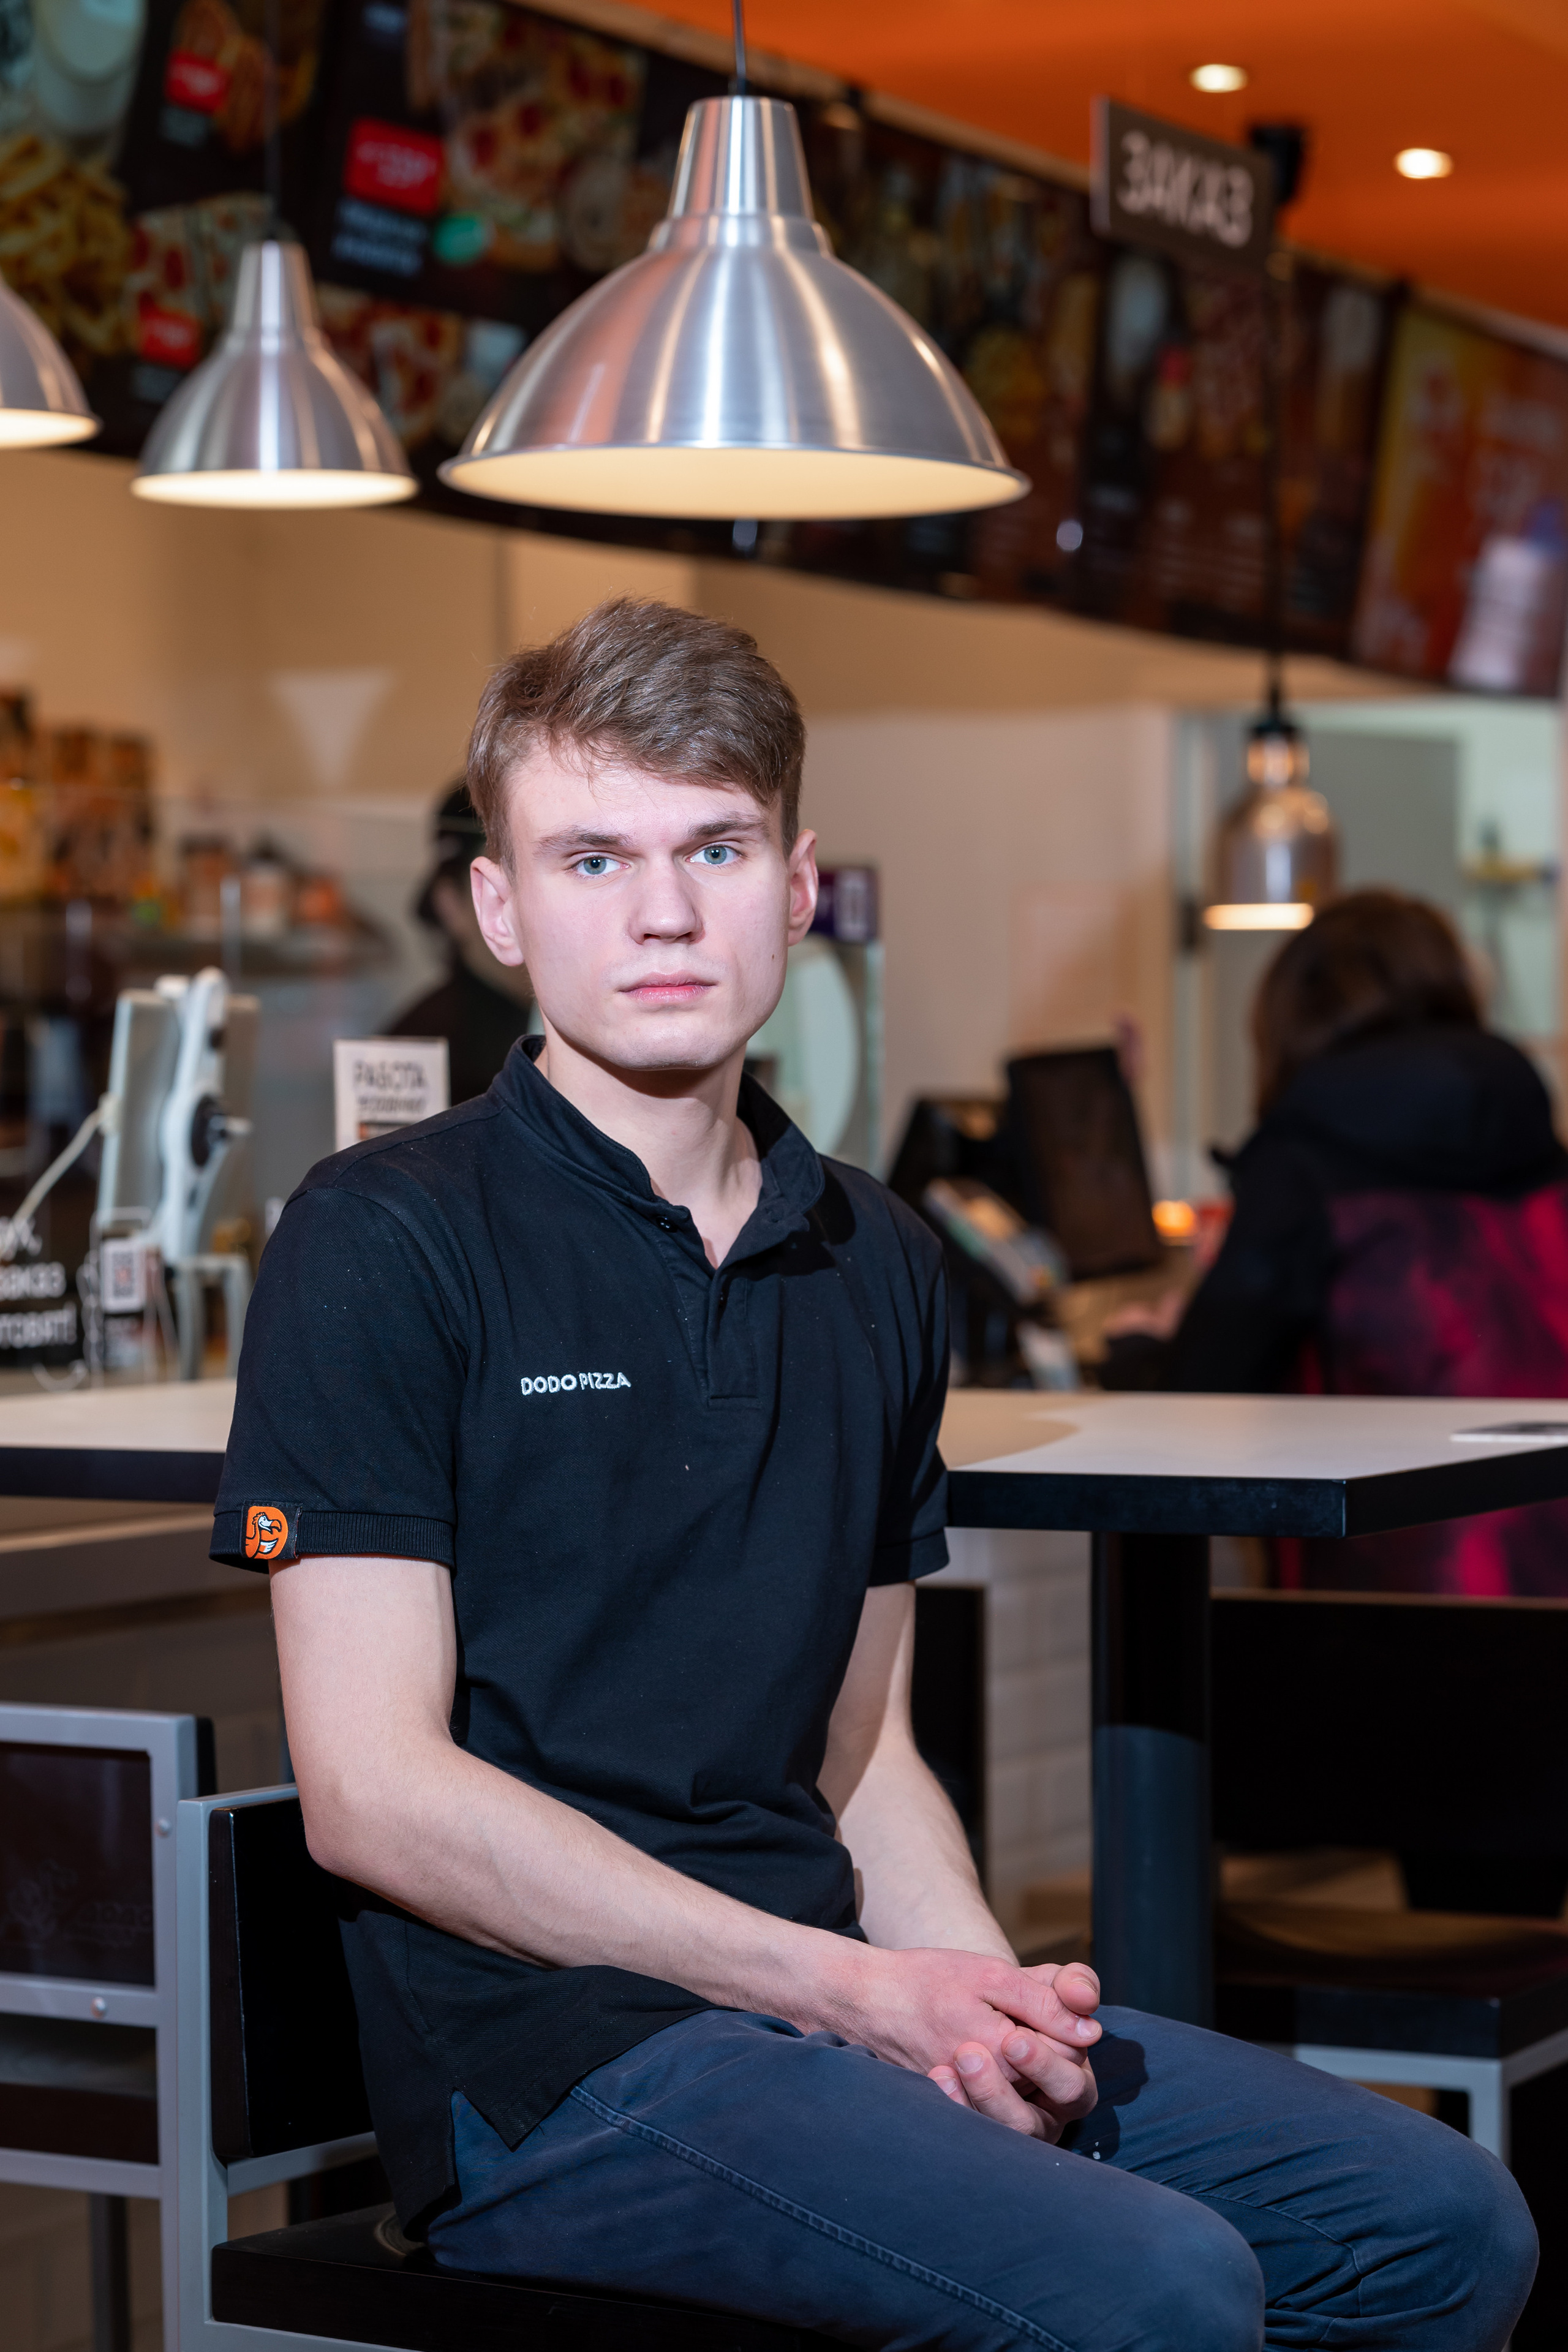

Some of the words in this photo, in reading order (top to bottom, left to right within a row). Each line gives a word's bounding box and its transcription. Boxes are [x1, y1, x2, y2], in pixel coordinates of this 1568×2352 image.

[1118, 130, 1254, 247] ЗАКАЗ
[521, 1374, 578, 1395] DODO
[579, 1372, 631, 1390] PIZZA
